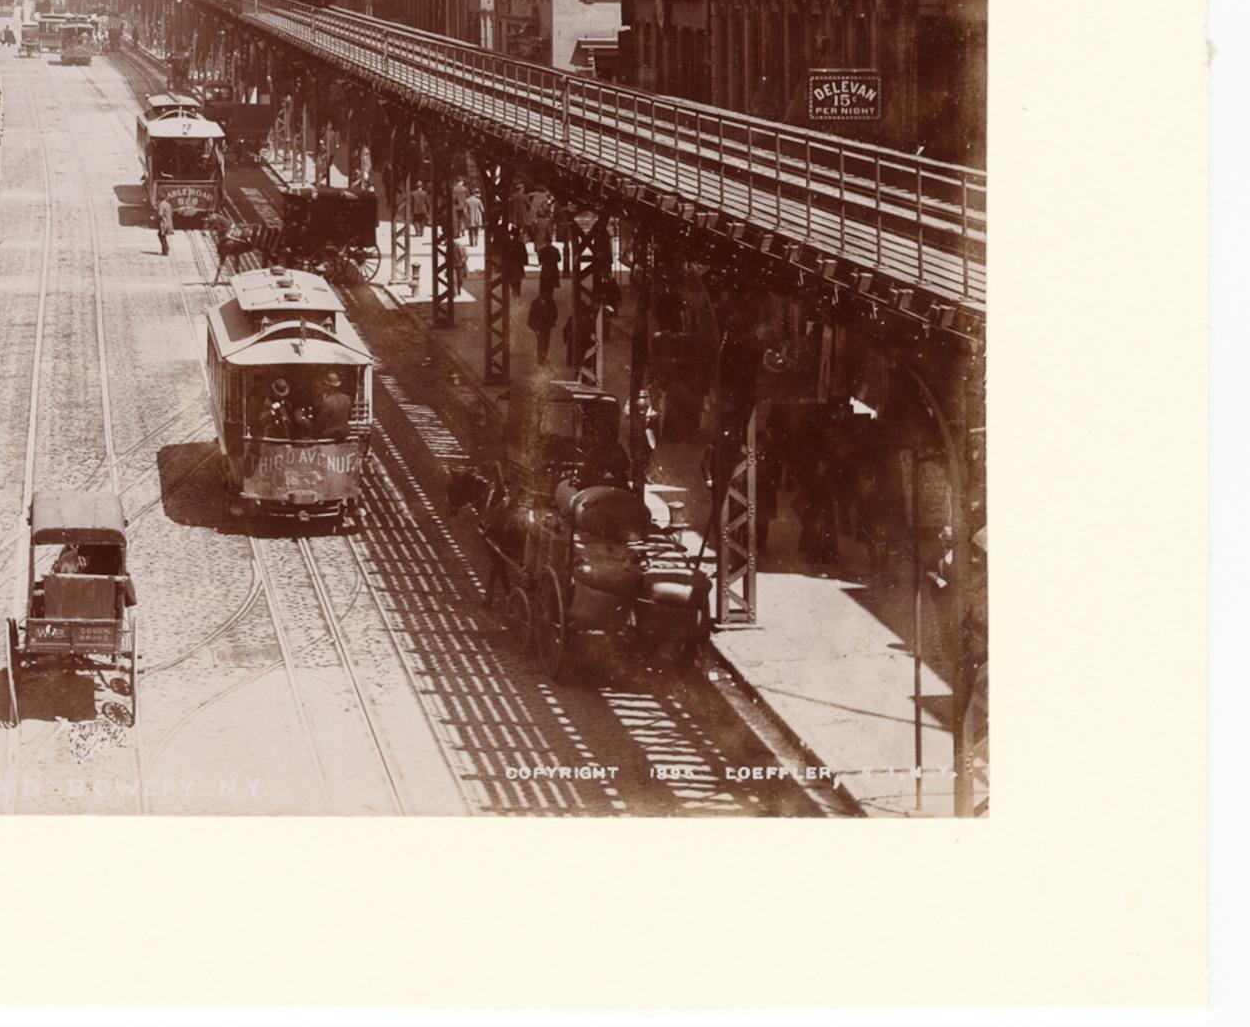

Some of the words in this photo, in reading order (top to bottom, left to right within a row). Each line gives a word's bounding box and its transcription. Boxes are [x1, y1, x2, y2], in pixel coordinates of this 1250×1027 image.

[813, 80, 877, 102] DELEVAN
[815, 107, 838, 115] PER
[841, 107, 876, 115] NIGHT
